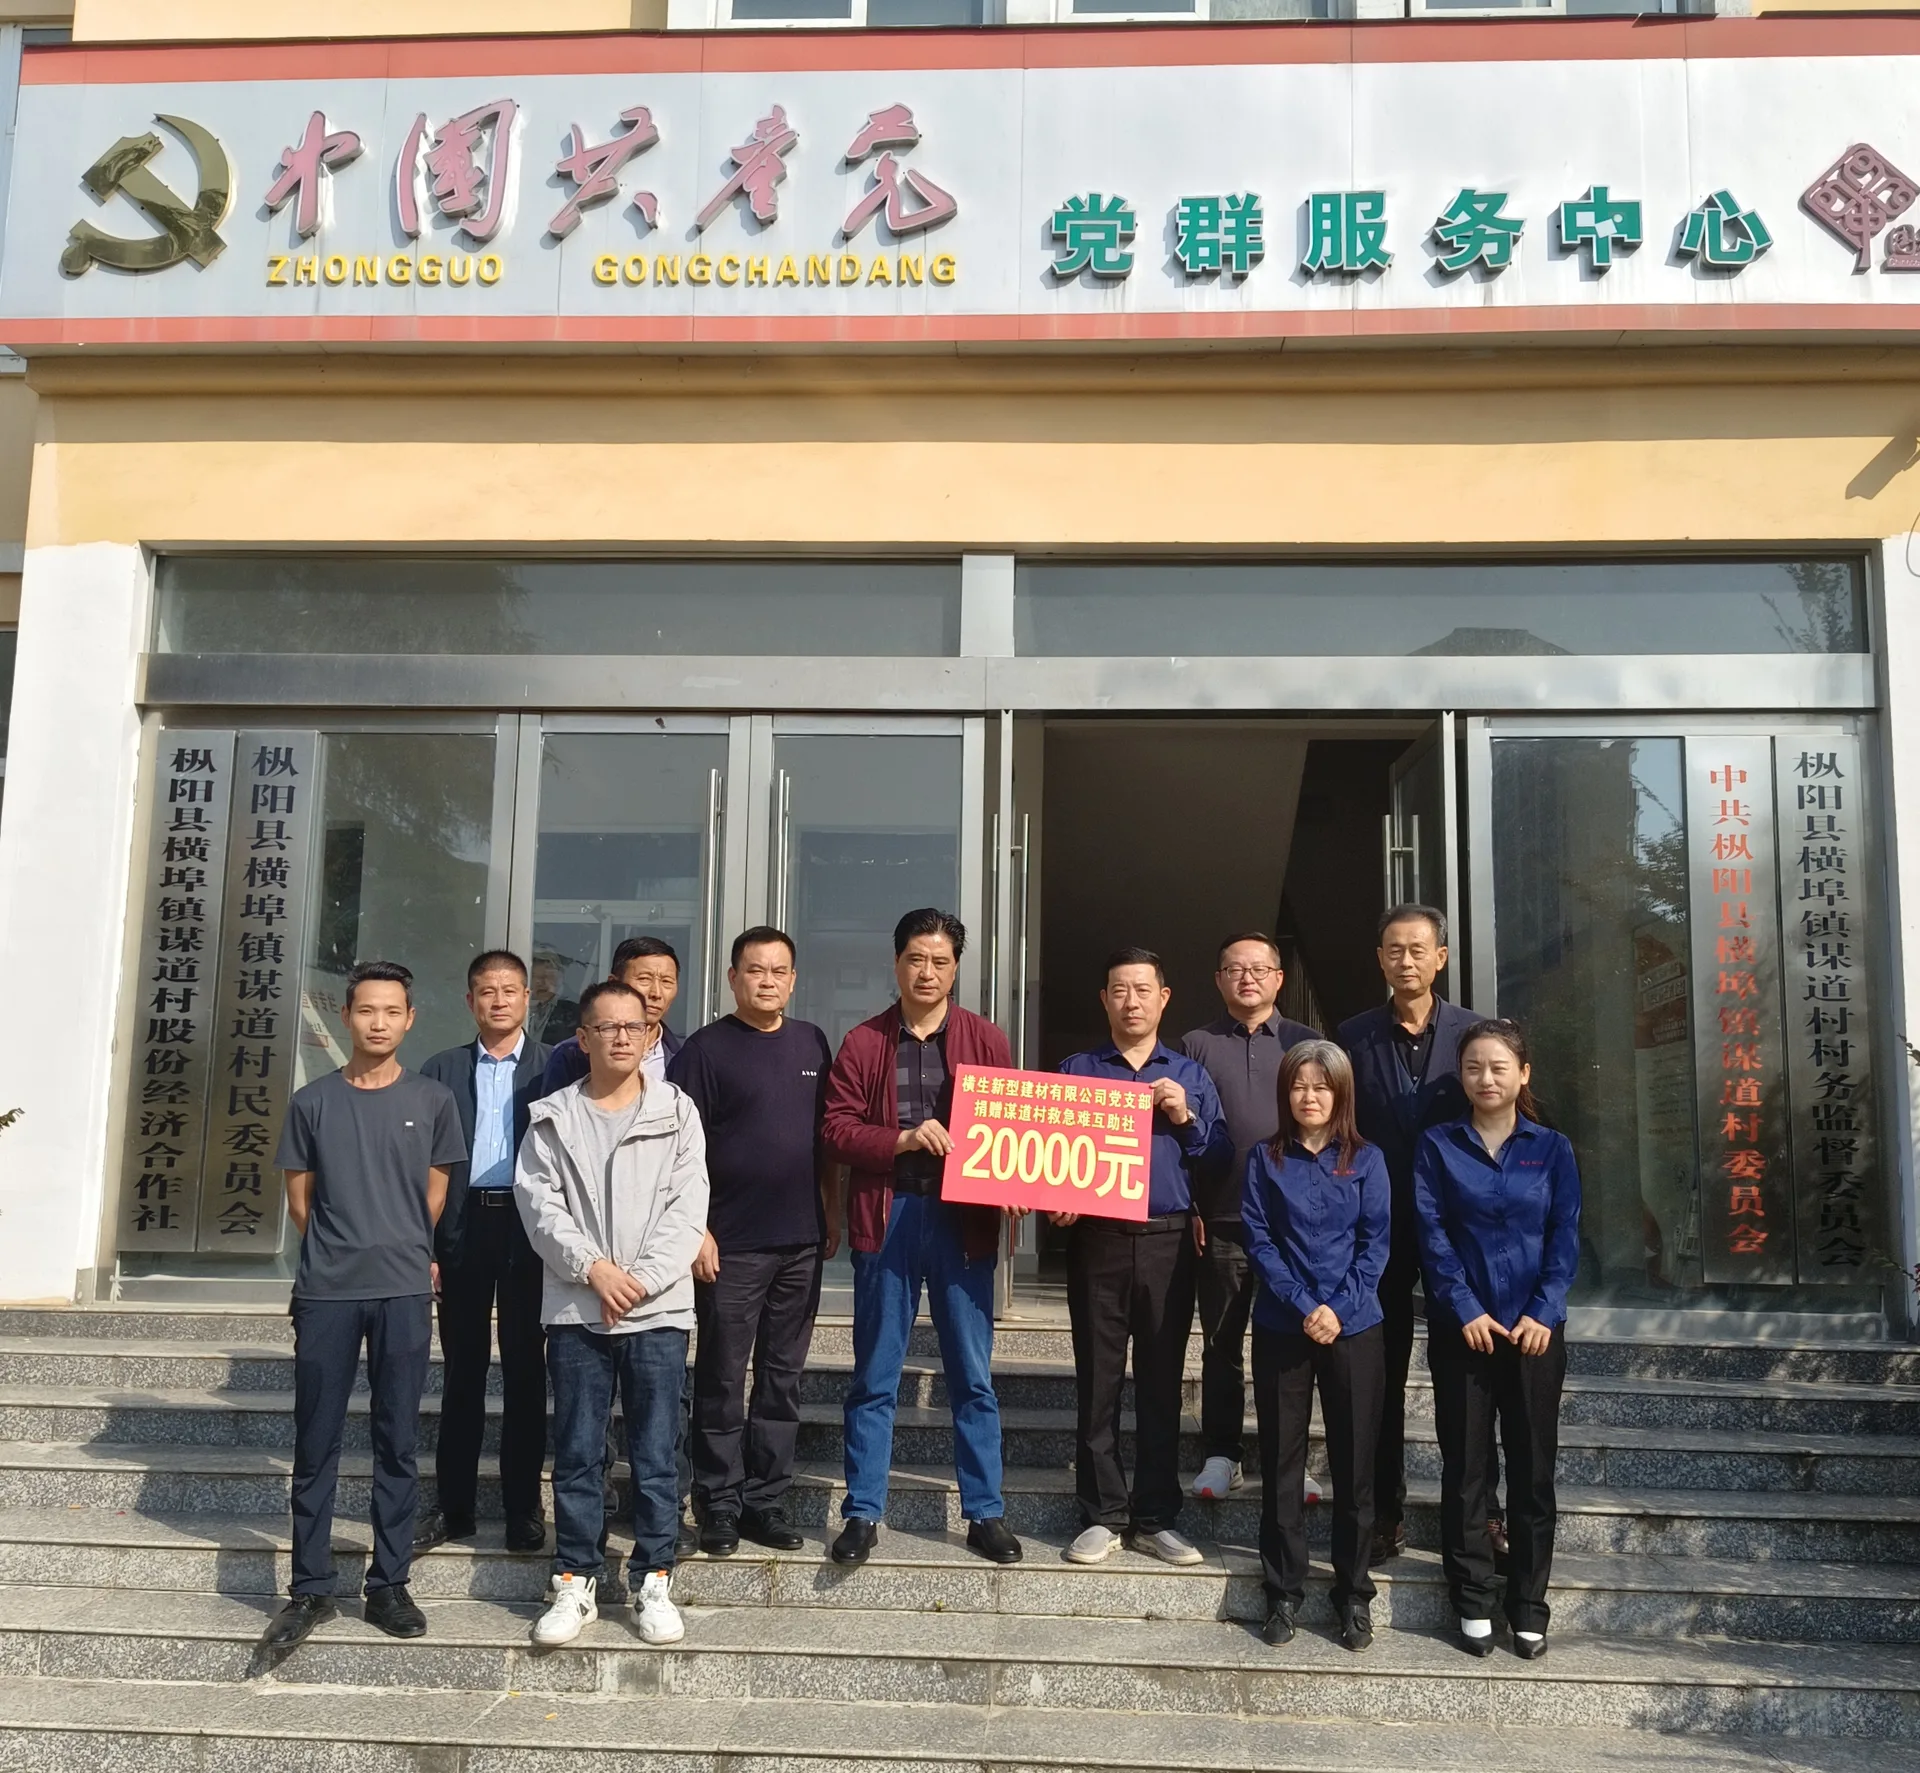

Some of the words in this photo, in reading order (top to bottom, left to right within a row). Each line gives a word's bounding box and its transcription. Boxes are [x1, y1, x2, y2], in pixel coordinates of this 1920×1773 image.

[267, 255, 503, 285] ZHONGGUO
[594, 255, 957, 285] GONGCHANDANG
[1051, 186, 1773, 274] 党群服务中心
[131, 748, 217, 1232] 枞阳县横埠镇谋道村股份经济合作社
[216, 746, 299, 1235] 枞阳县横埠镇谋道村民委员会
[1709, 764, 1769, 1254] 中共枞阳县横埠镇谋道村委员会
[1793, 751, 1866, 1268] 枞阳县横埠镇谋道村村务监督委员会
[962, 1074, 1152, 1111] 横生新型建材有限公司党支部
[974, 1099, 1136, 1132] 捐赠谋道村救急难互助社
[961, 1123, 1145, 1200] 20000元
